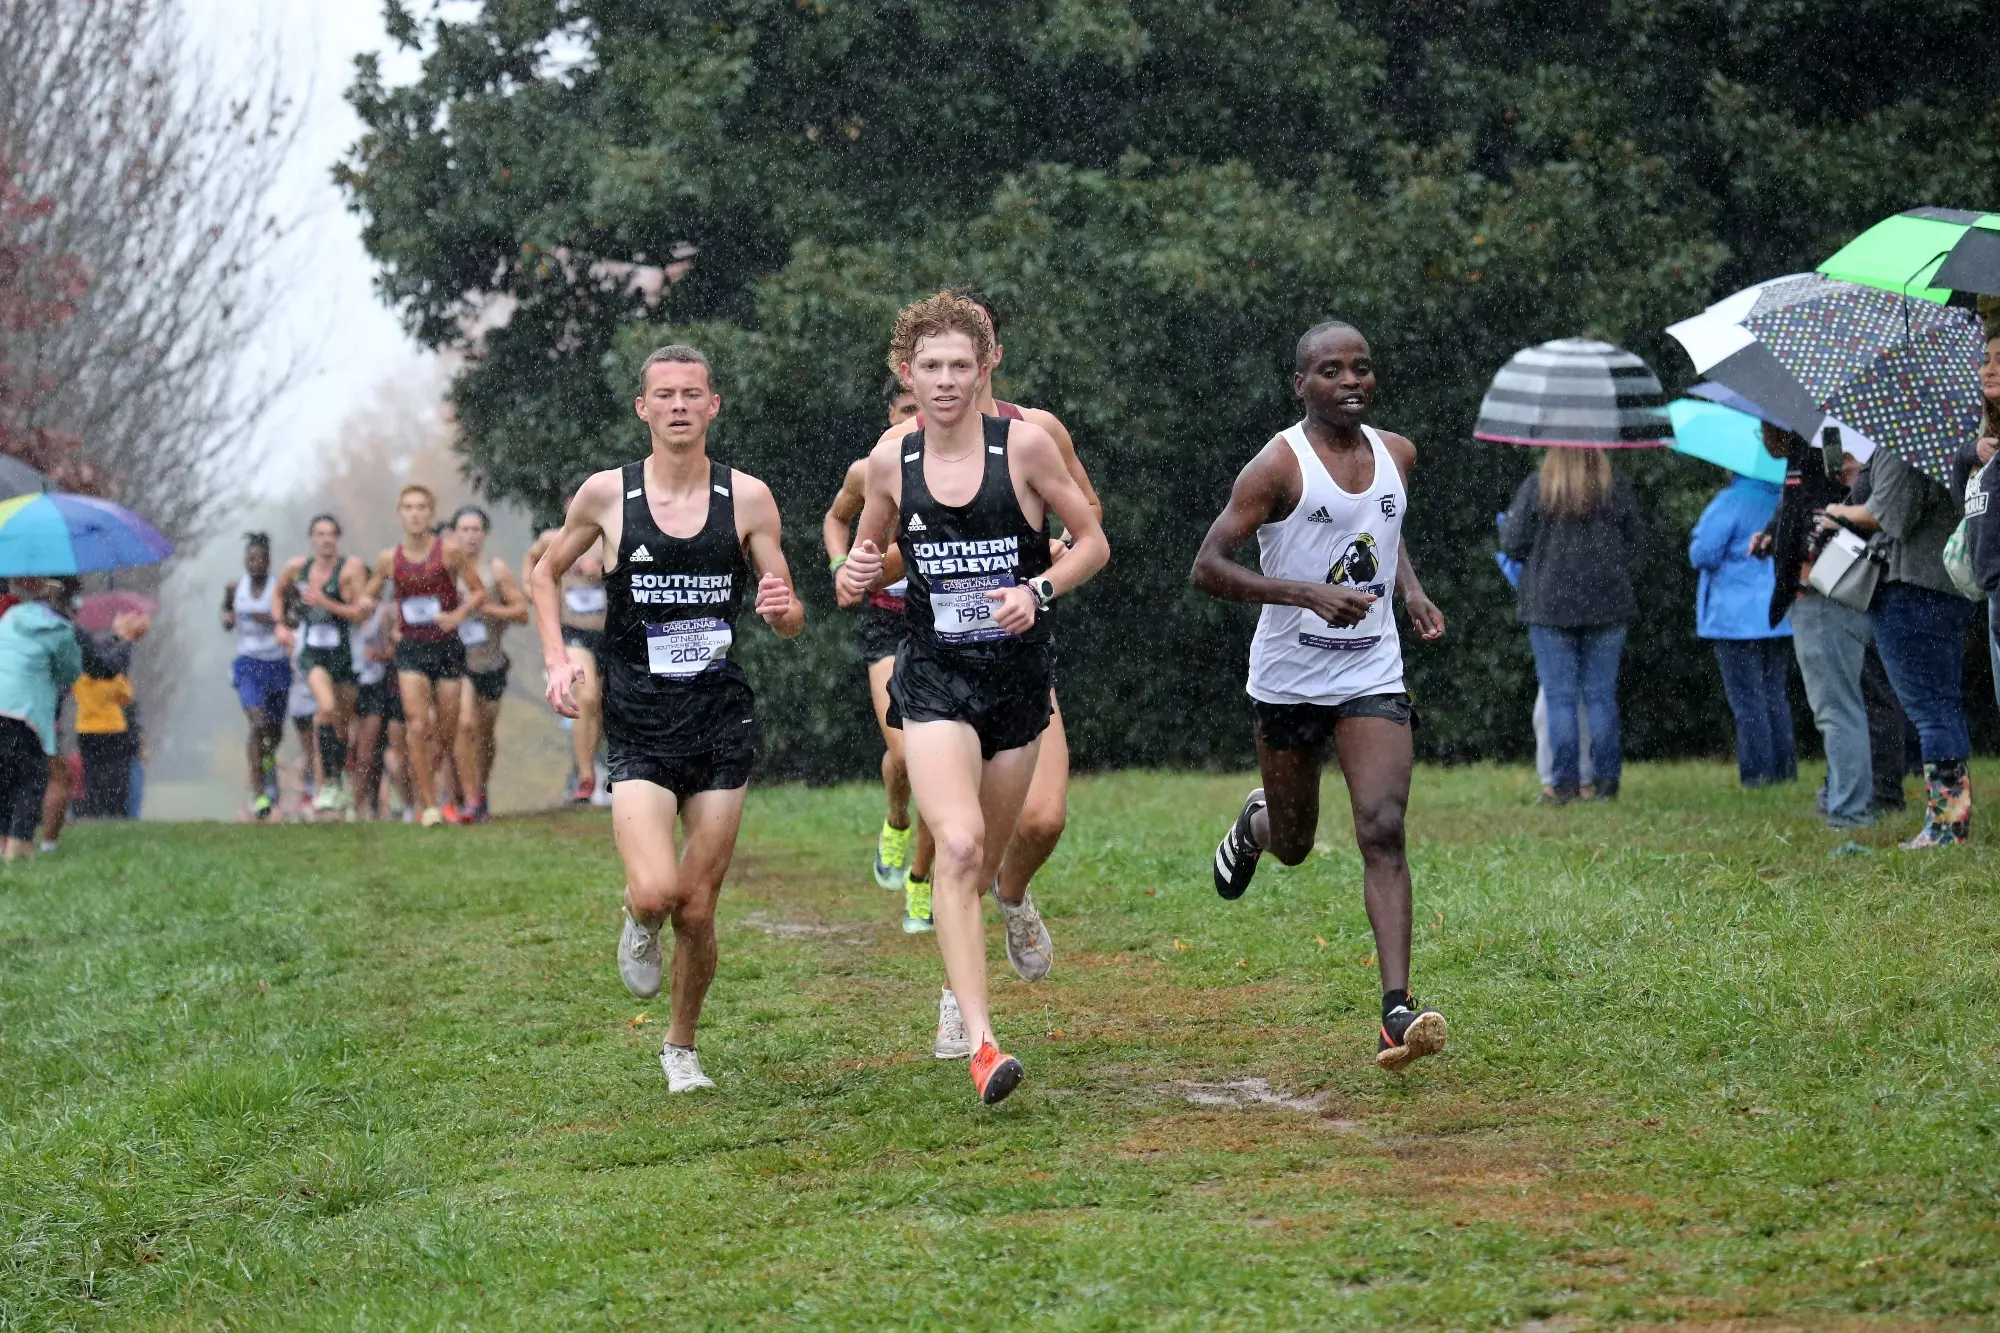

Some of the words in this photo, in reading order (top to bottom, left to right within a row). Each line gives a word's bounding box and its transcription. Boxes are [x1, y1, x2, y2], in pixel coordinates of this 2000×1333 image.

[1308, 516, 1332, 524] adidas
[913, 536, 1018, 558] SOUTHERN
[916, 552, 1019, 575] WESLEYAN
[631, 574, 732, 588] SOUTHERN
[943, 579, 1000, 591] CAROLINAS
[631, 588, 732, 603] WESLEYAN
[956, 605, 990, 623] 198
[662, 621, 716, 634] CAROLINAS
[671, 634, 708, 643] O'NEILL
[671, 647, 711, 663] 202
